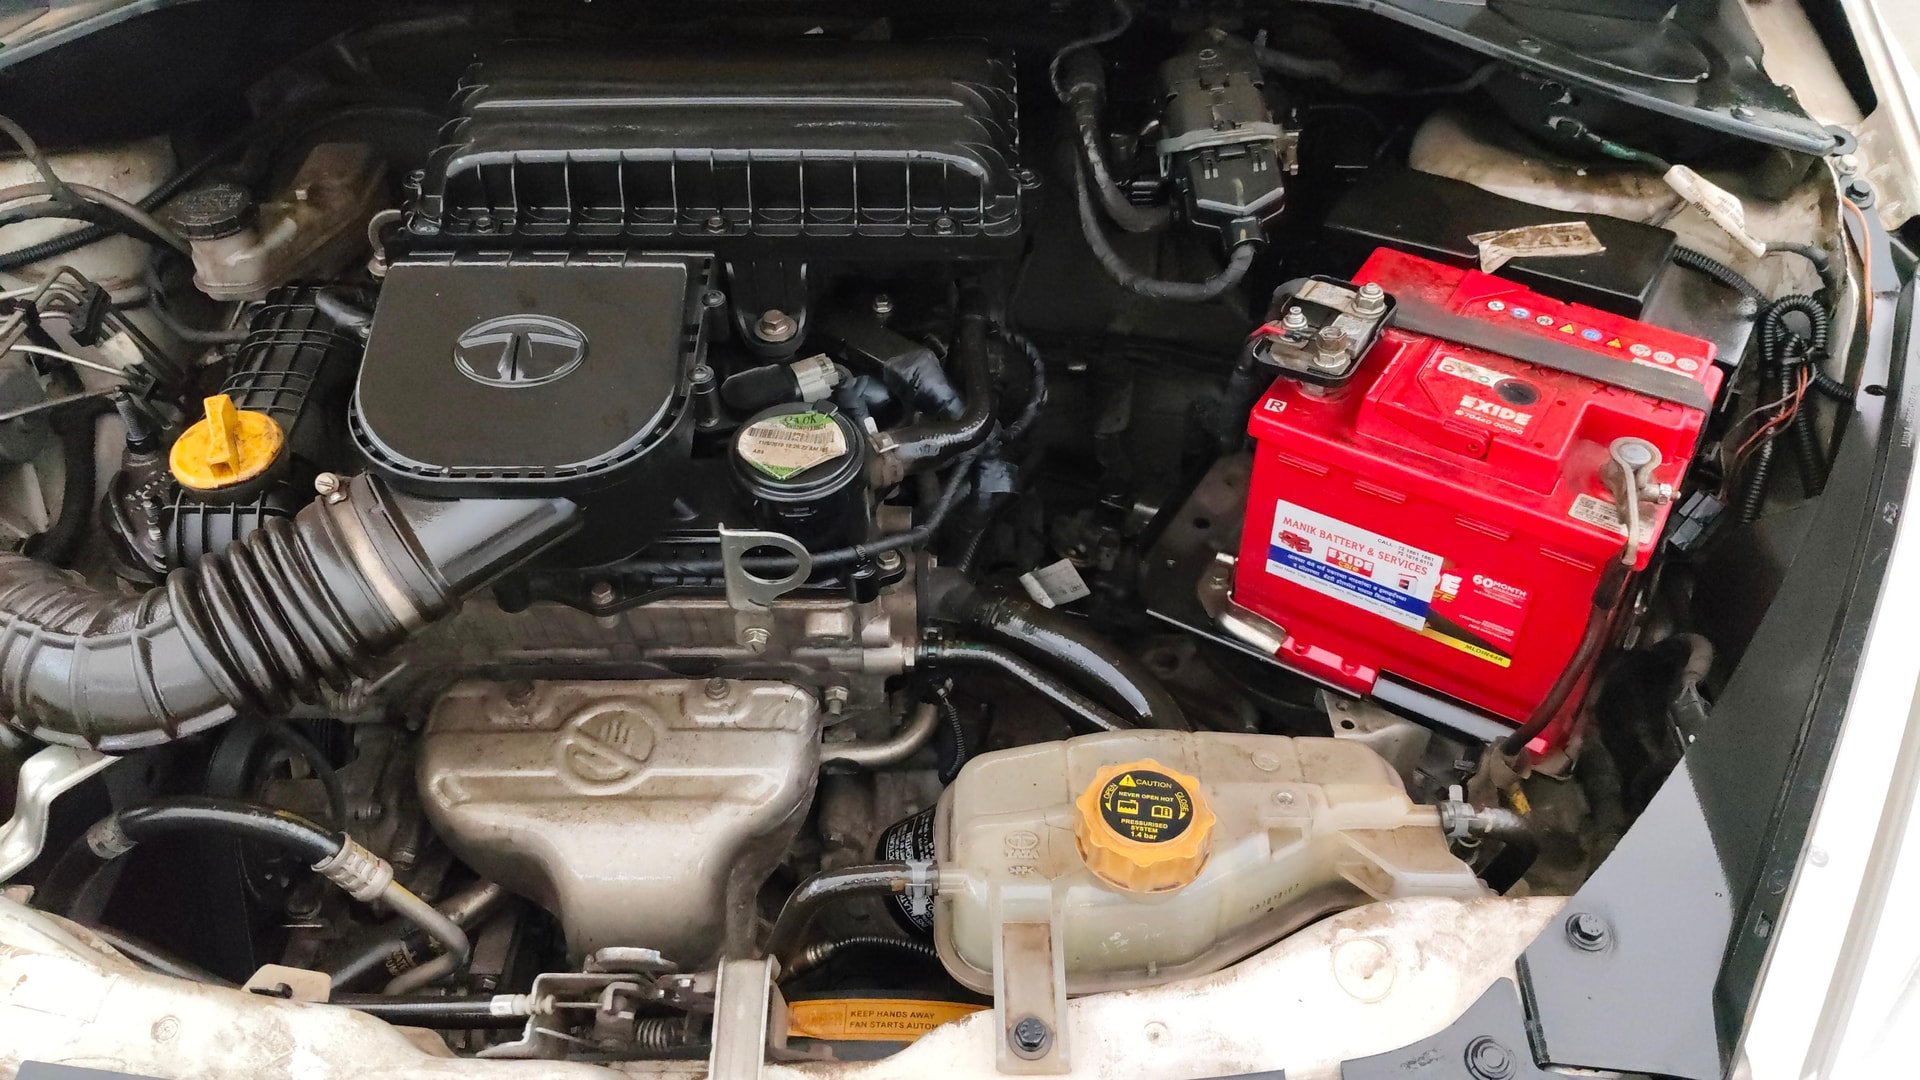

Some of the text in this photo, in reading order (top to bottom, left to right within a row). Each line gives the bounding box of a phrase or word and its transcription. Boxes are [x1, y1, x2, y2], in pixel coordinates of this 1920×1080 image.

[1268, 399, 1283, 411] R
[1459, 395, 1532, 426] EXIDE
[1282, 516, 1429, 576] MANIK BATTERY & SERVICES
[1327, 548, 1374, 572] EXIDE
[1337, 560, 1359, 573] care
[1472, 573, 1493, 589] 60
[1493, 580, 1527, 597] MONTH
[1136, 778, 1172, 789] CAUTION
[1103, 783, 1118, 799] OPEN
[1118, 791, 1140, 799] NEVER
[1141, 793, 1160, 801] OPEN
[1177, 791, 1190, 812] CLOSE
[1120, 818, 1168, 829] PRESSURISED
[1130, 825, 1158, 833] SYSTEM
[1144, 832, 1157, 840] bar
[850, 1010, 874, 1018] KEEP
[877, 1011, 907, 1019] HANDS
